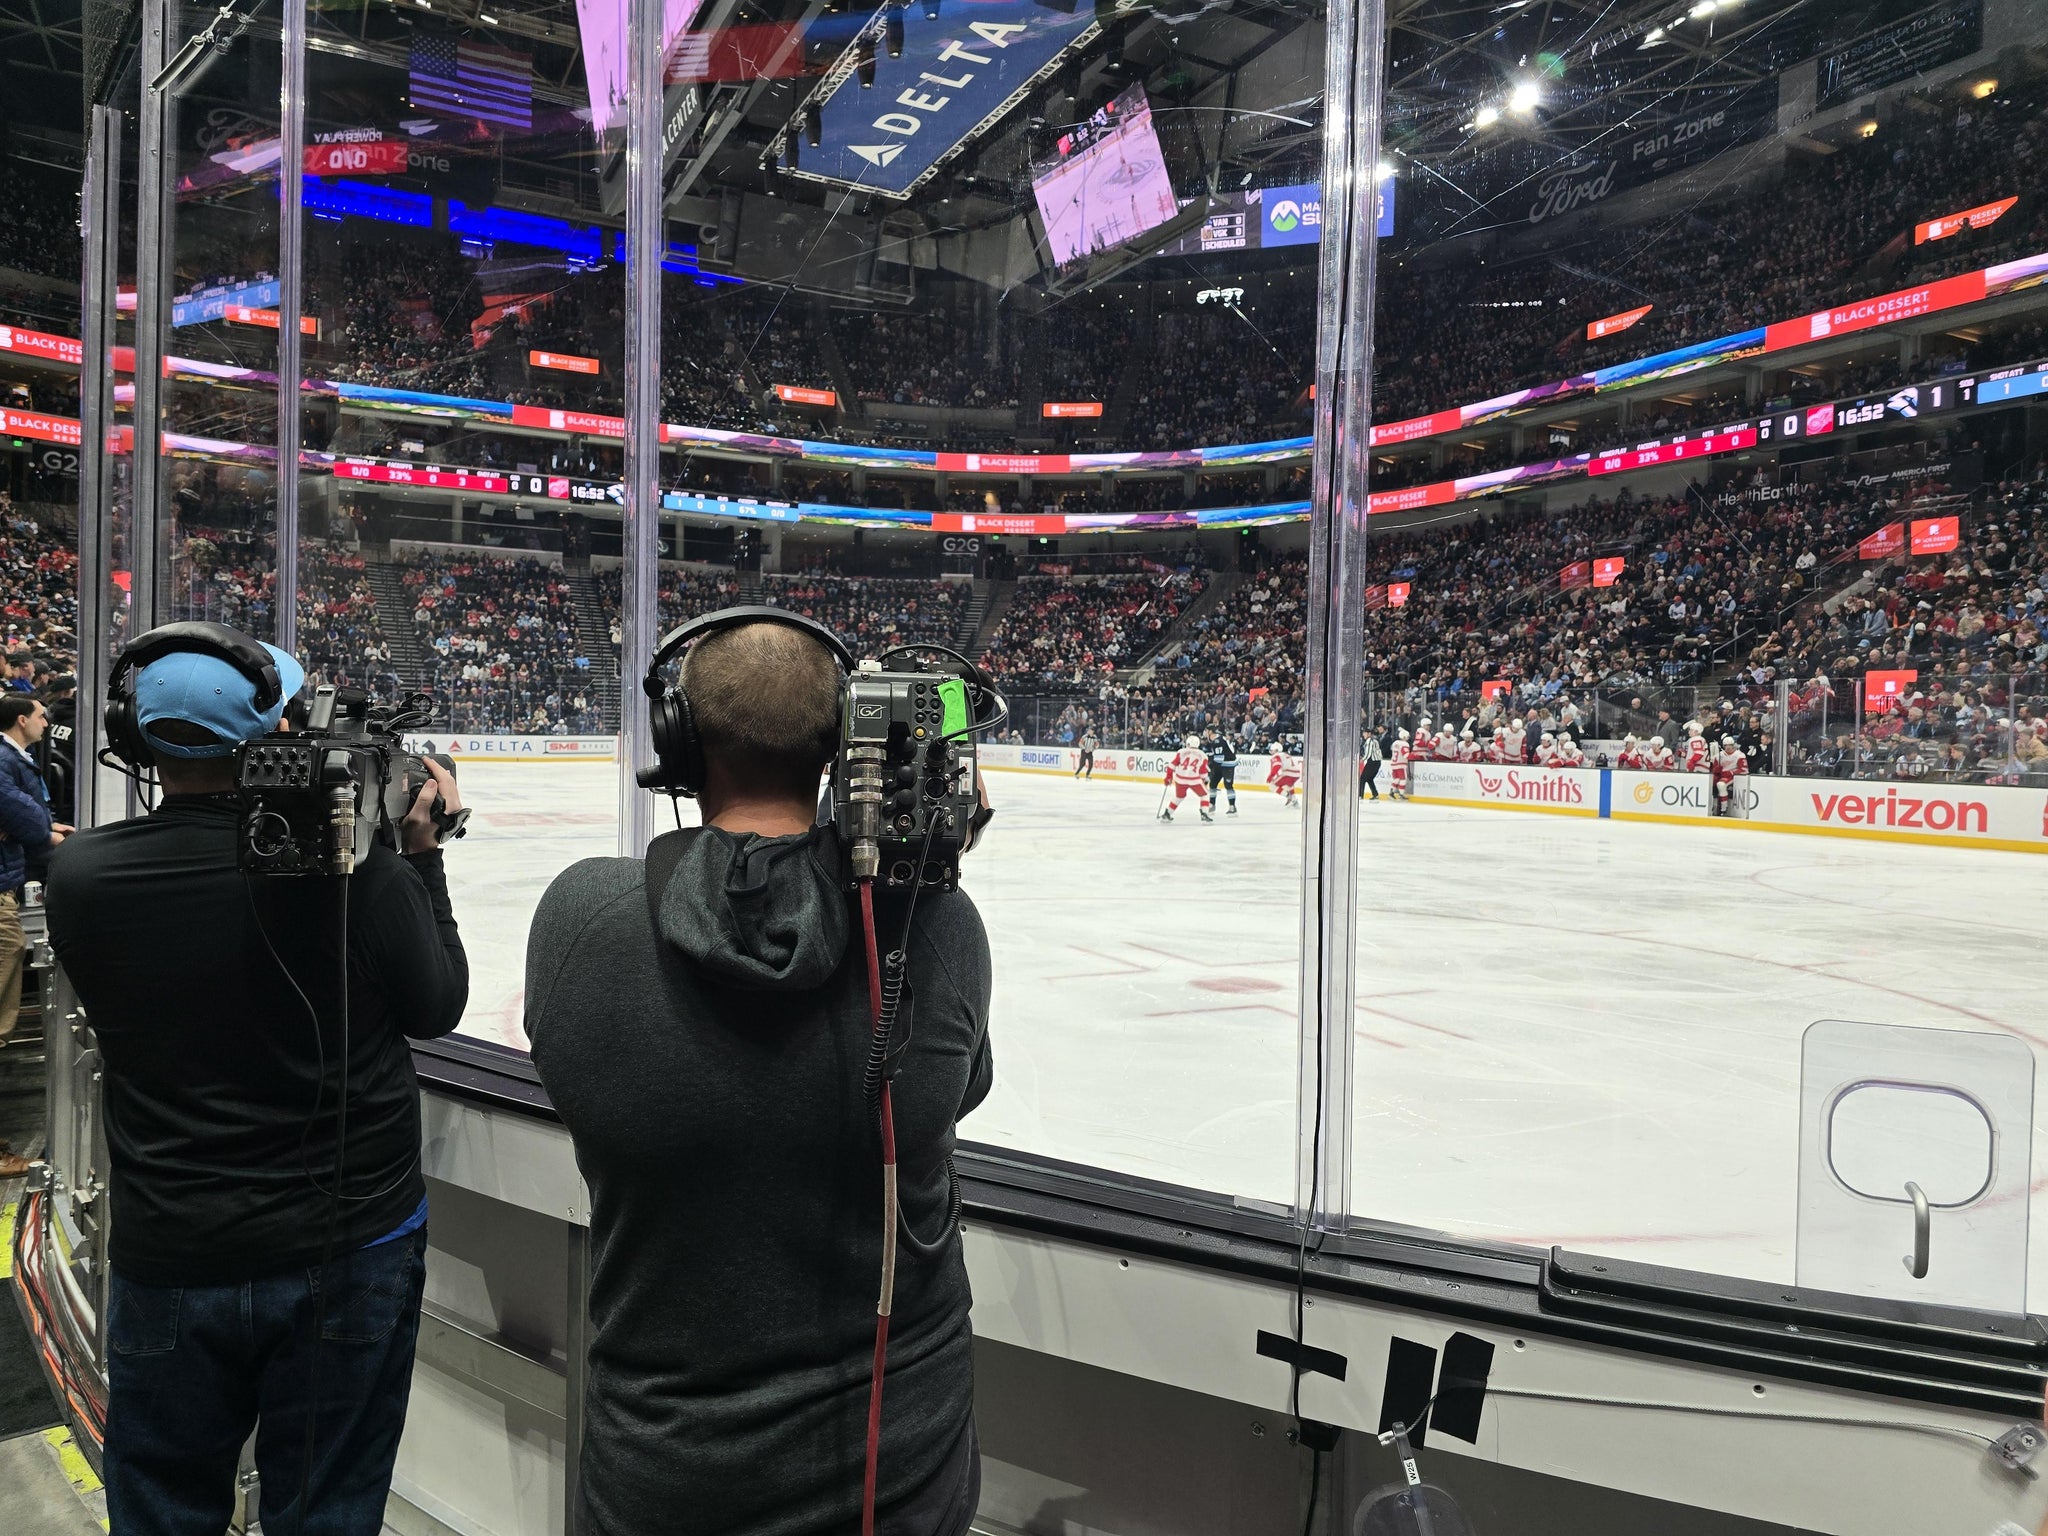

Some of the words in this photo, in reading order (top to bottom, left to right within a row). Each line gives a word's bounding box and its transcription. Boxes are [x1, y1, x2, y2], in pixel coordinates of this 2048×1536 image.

[873, 20, 1027, 136] DELTA
[667, 87, 698, 144] CENTER
[1632, 134, 1669, 161] Fan
[1674, 110, 1726, 145] Zone
[1529, 160, 1617, 223] Ford
[1213, 218, 1228, 227] VAN
[1835, 304, 1875, 325] BLACK
[1878, 290, 1930, 314] DESERT
[1878, 305, 1929, 323] RESORT
[16, 333, 56, 350] BLACK
[1963, 388, 1971, 400] 1
[1783, 415, 1798, 435] 0
[1838, 402, 1886, 427] 16:52
[1931, 386, 1942, 407] 1
[9, 415, 50, 431] BLACK
[567, 415, 597, 427] BLACK
[1378, 427, 1403, 438] BLACK
[1404, 419, 1432, 433] DESERT
[1761, 428, 1770, 439] 0
[1604, 460, 1621, 470] 0/0
[1638, 452, 1660, 464] 33%
[1675, 446, 1683, 457] 0
[1704, 441, 1712, 452] 3
[1731, 435, 1740, 446] 0
[43, 450, 78, 473] G2
[982, 458, 1007, 466] BLACK
[1009, 459, 1039, 467] DESERT
[1891, 467, 1926, 479] AMERICA
[530, 478, 542, 493] 0
[571, 485, 605, 500] 16:52
[1373, 495, 1398, 506] BLACK
[1400, 490, 1427, 502] DESERT
[977, 519, 1003, 527] BLACK
[943, 537, 980, 552] G2G
[470, 741, 532, 752] DELTA
[550, 742, 579, 750] SME
[1022, 753, 1038, 763] BUD
[1038, 754, 1060, 765] LIGHT
[1135, 758, 1153, 772] Ken
[1181, 756, 1199, 773] 44
[1506, 770, 1583, 804] Smith's
[1811, 788, 1988, 833] verizon
[1406, 1461, 1417, 1481] W25
